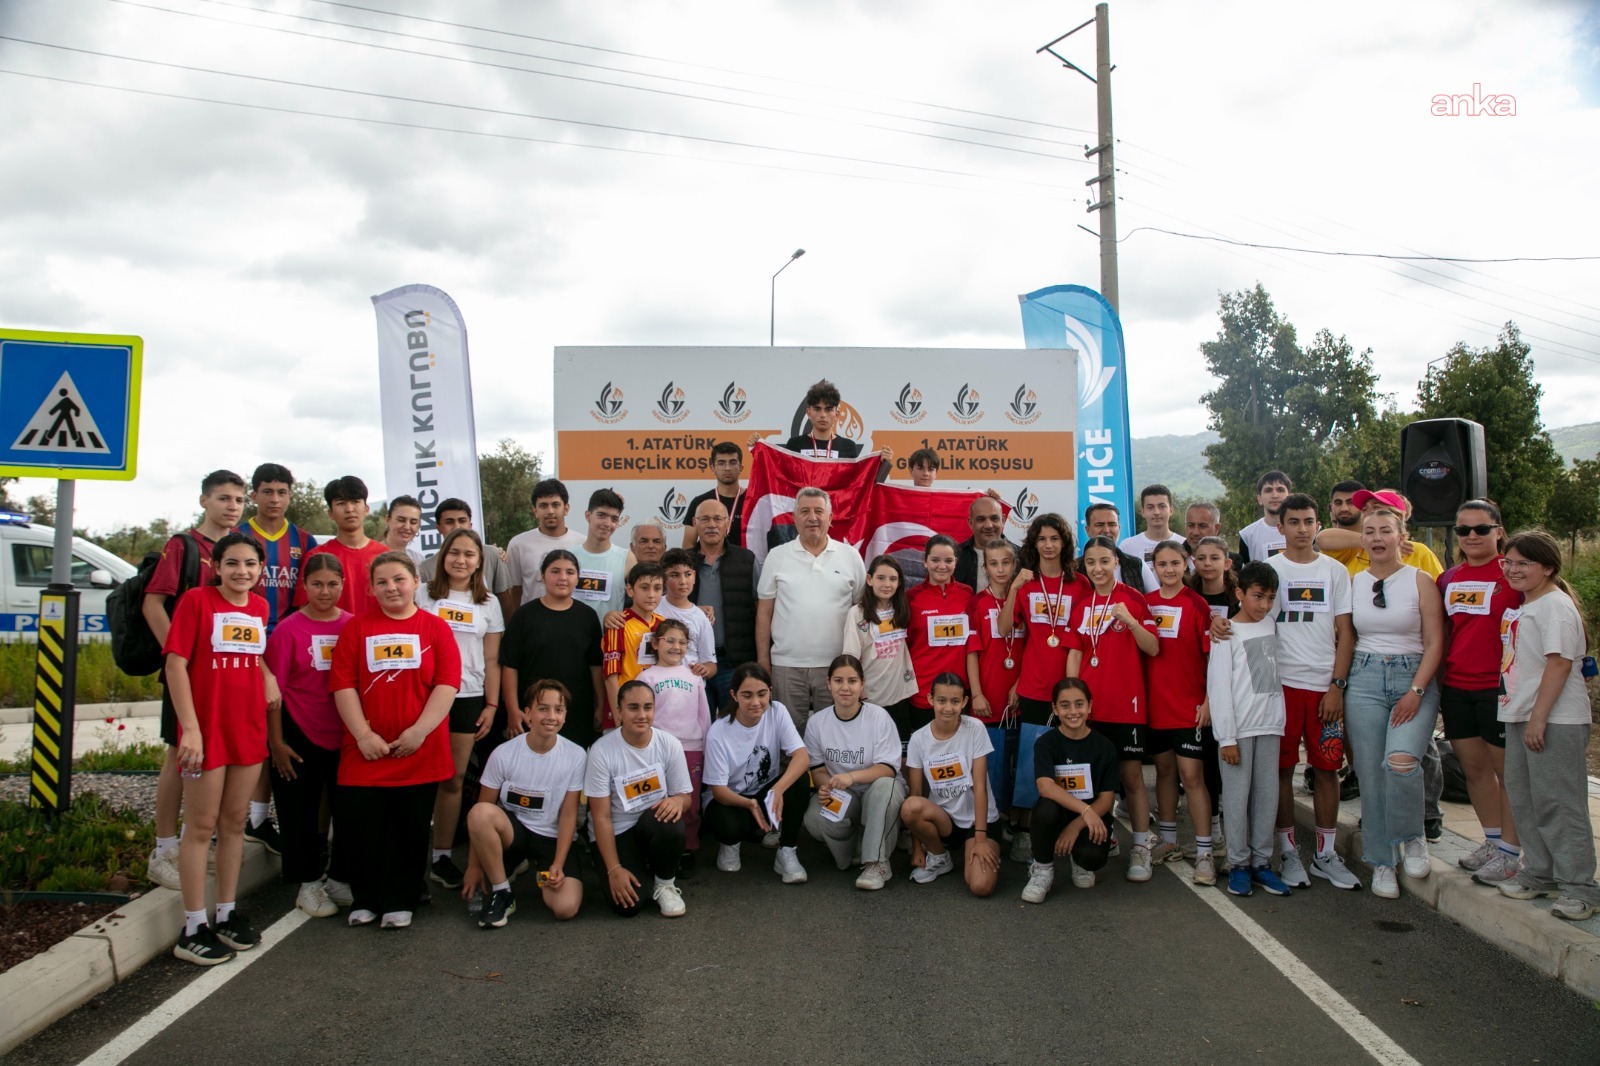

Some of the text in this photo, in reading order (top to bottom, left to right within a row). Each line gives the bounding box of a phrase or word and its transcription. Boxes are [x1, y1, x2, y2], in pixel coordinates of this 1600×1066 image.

[626, 435, 717, 450] 1. ATATÜRK
[921, 436, 1009, 451] 1. ATATÜRK
[601, 454, 712, 473] GENÇLİK KOŞ
[968, 457, 1034, 473] KOŞUSU
[262, 565, 299, 580] ATAR
[582, 578, 599, 590] 21
[1301, 588, 1312, 601] 4
[1455, 593, 1477, 604] 24
[447, 610, 464, 622] 18
[232, 627, 252, 641] 28
[943, 625, 956, 637] 11
[383, 645, 404, 658] 14
[655, 679, 693, 694] OPTIMIST
[1131, 695, 1138, 713] 1
[1131, 728, 1138, 745] 1
[825, 747, 864, 765] mavi
[937, 766, 956, 779] 25
[633, 780, 651, 794] 16
[1061, 777, 1077, 789] 15
[520, 796, 530, 807] 8
